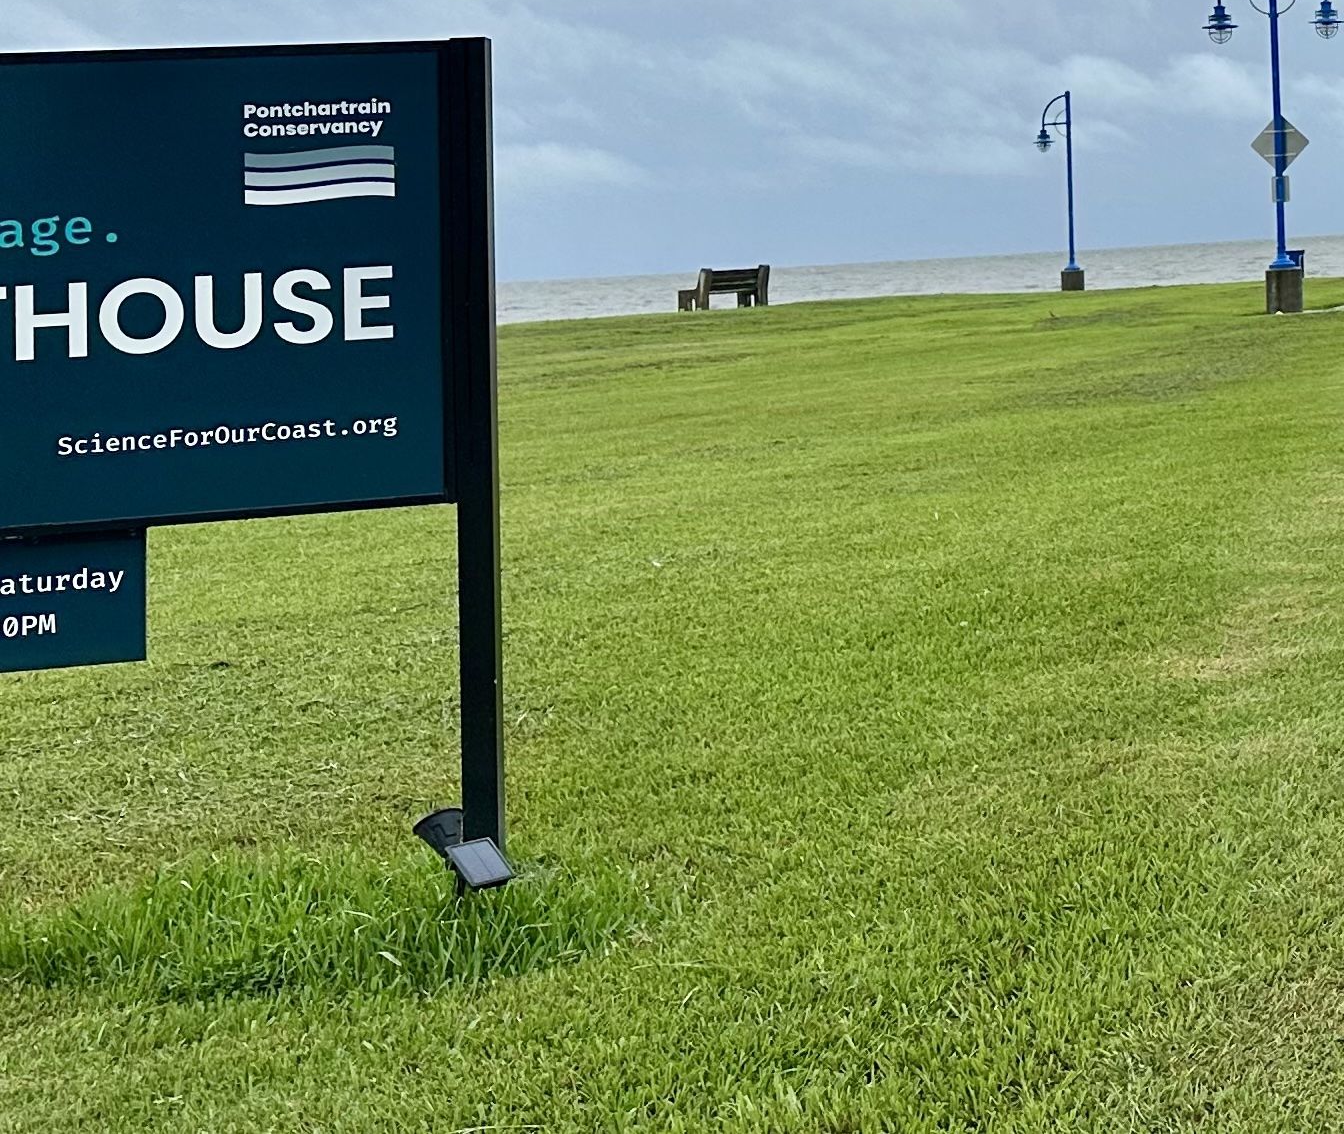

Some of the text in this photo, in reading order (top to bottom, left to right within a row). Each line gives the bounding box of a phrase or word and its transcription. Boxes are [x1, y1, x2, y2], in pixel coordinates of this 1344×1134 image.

[243, 97, 391, 119] Pontchartrain
[243, 120, 383, 137] Conservancy
[0, 215, 118, 257] age.
[0, 266, 394, 361] HOUSE
[57, 416, 398, 456] ScienceForOurCoast.org
[0, 567, 124, 595] aturday
[2, 613, 57, 638] 0PM
